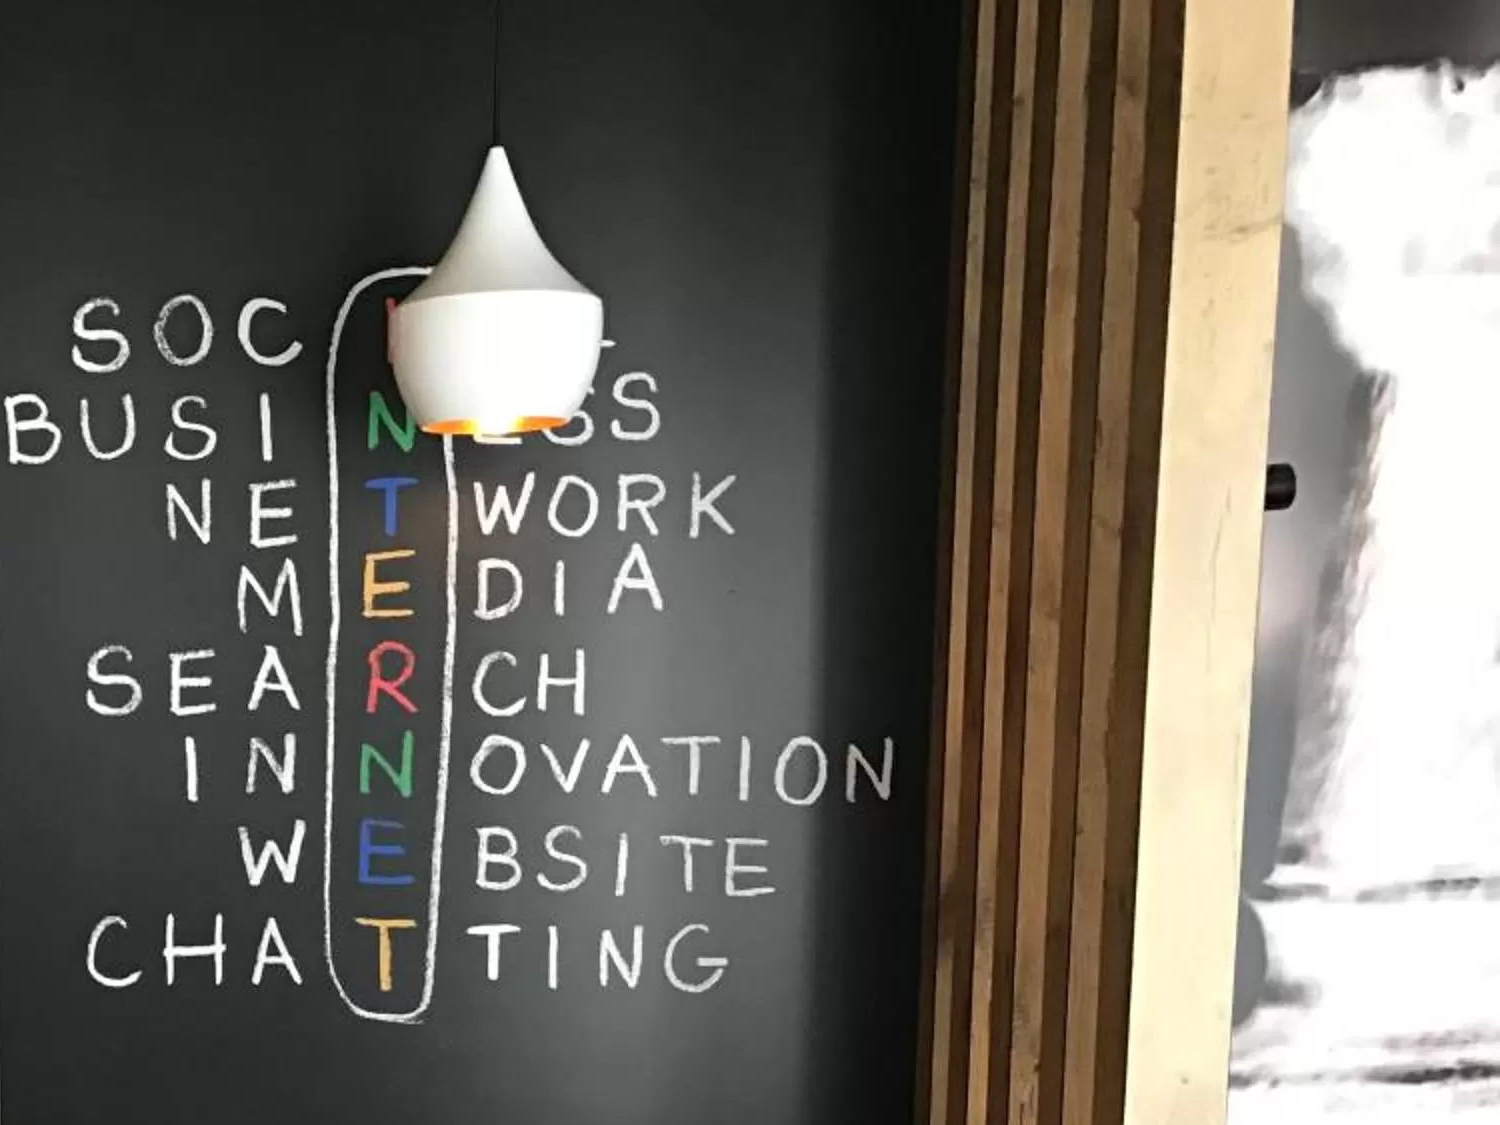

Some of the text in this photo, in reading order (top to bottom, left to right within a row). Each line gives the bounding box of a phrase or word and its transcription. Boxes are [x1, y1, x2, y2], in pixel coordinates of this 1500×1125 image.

[4, 371, 661, 464] BUSINSS
[166, 472, 737, 549] NETWORK
[237, 543, 664, 635] MEDIA
[85, 641, 588, 716] SEARCH
[185, 731, 895, 806] INNOVATION
[238, 818, 776, 897] WEBSITE
[86, 913, 730, 992] CHATTING
